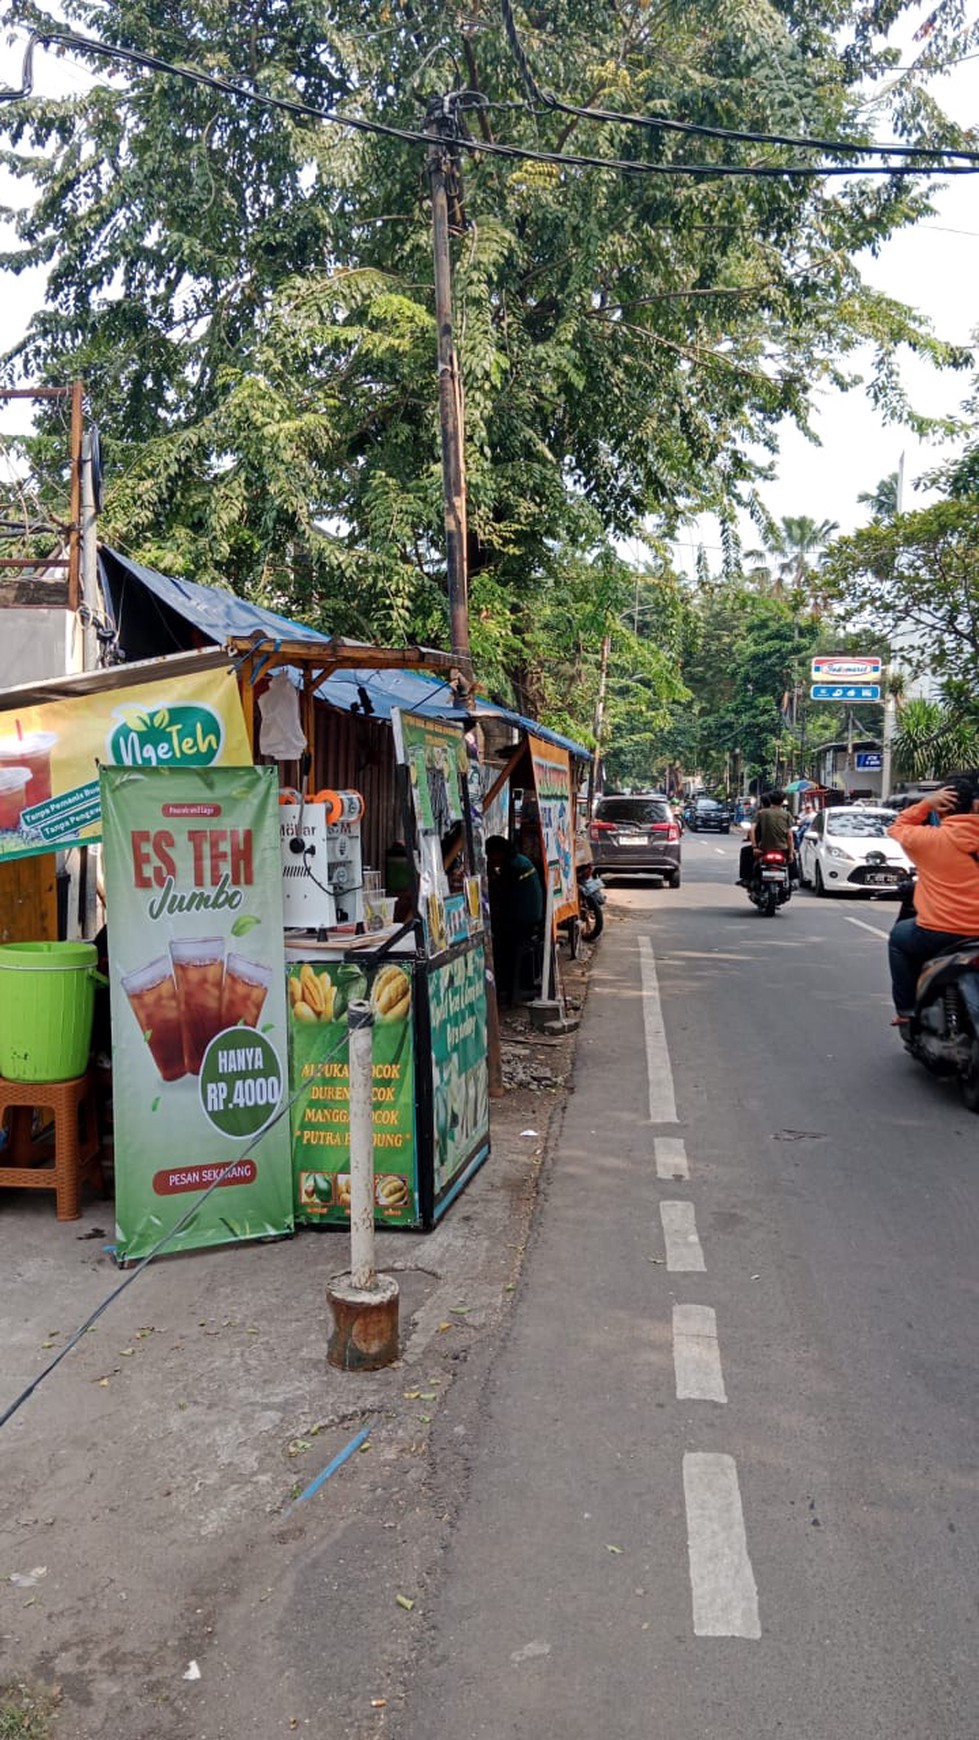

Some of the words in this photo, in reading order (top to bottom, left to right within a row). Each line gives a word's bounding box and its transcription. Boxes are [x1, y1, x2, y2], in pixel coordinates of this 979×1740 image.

[25, 808, 51, 822] Tanpa
[50, 792, 84, 812] Pemanis
[44, 820, 70, 835] Tanpa
[131, 829, 176, 888] ES
[187, 828, 253, 887] TEH
[149, 872, 242, 920] Jumbo
[218, 1047, 264, 1073] HANYA
[207, 1076, 280, 1112] RP.4000
[305, 1109, 350, 1122] MANGG
[303, 1131, 341, 1145] PUTRA
[169, 1171, 200, 1186] PESAN
